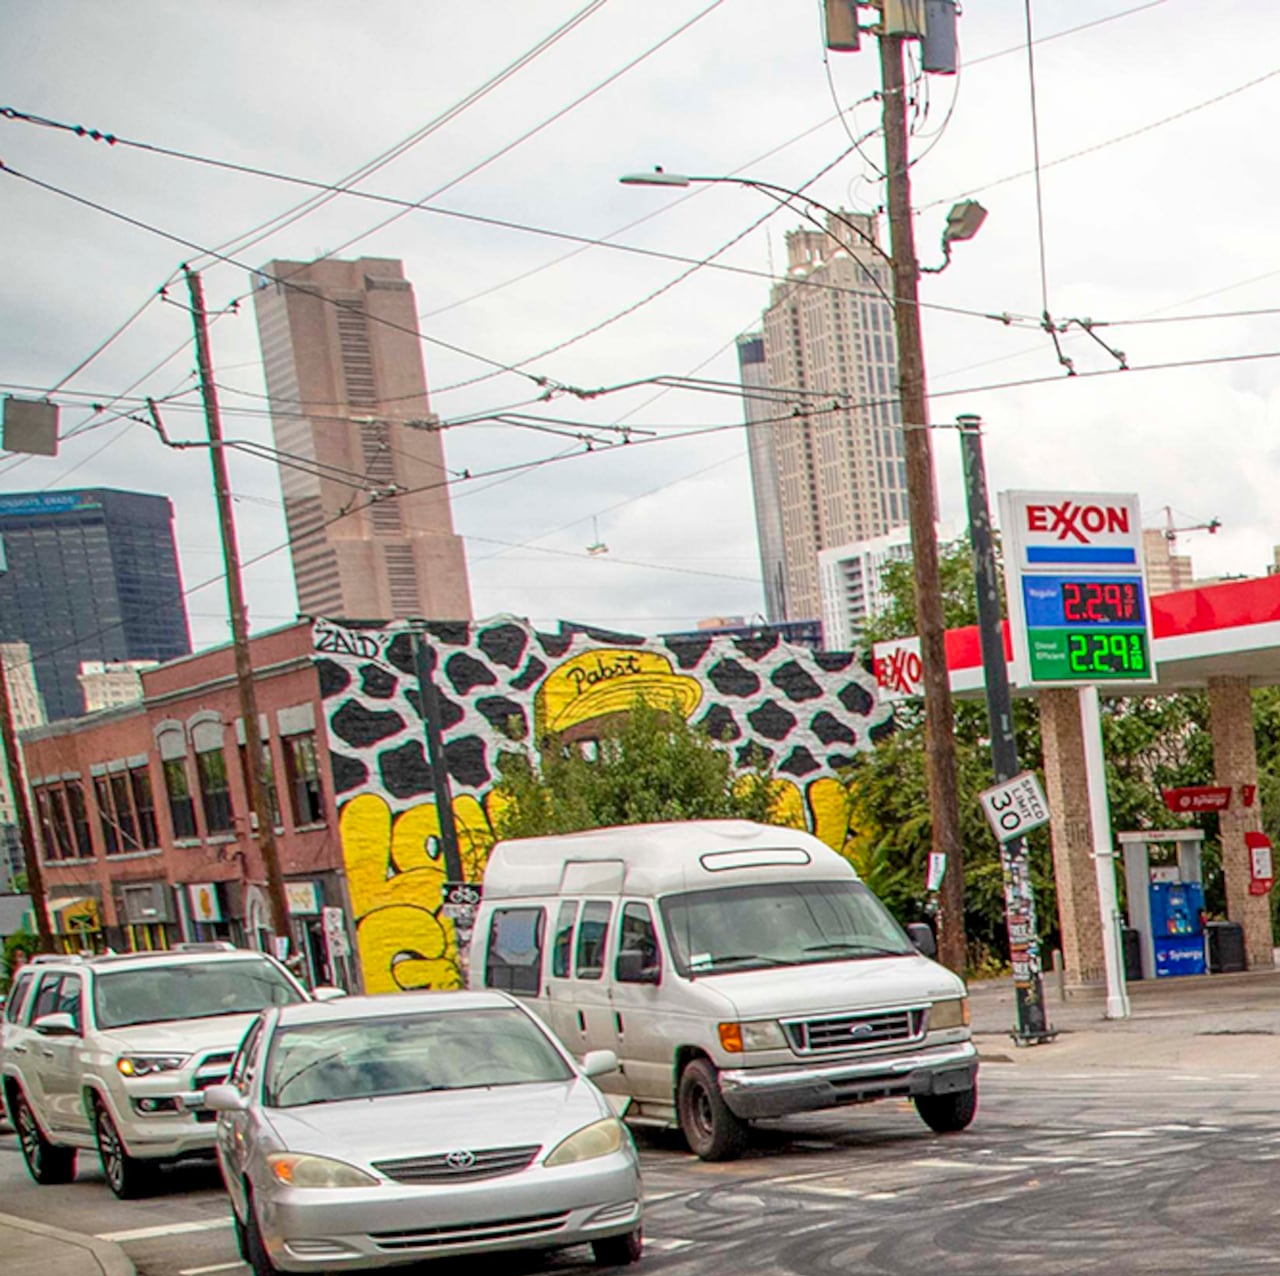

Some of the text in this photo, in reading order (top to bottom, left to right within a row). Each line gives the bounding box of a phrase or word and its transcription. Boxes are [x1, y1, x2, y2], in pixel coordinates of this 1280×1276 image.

[1026, 501, 1129, 544] EXXON
[1064, 584, 1122, 620] 2.29
[873, 647, 923, 695] EXXO
[1071, 635, 1129, 671] 2.29
[566, 655, 641, 695] Pabst
[992, 792, 1020, 830] 30
[1012, 788, 1032, 818] LIMIT
[1021, 780, 1044, 819] SPEED
